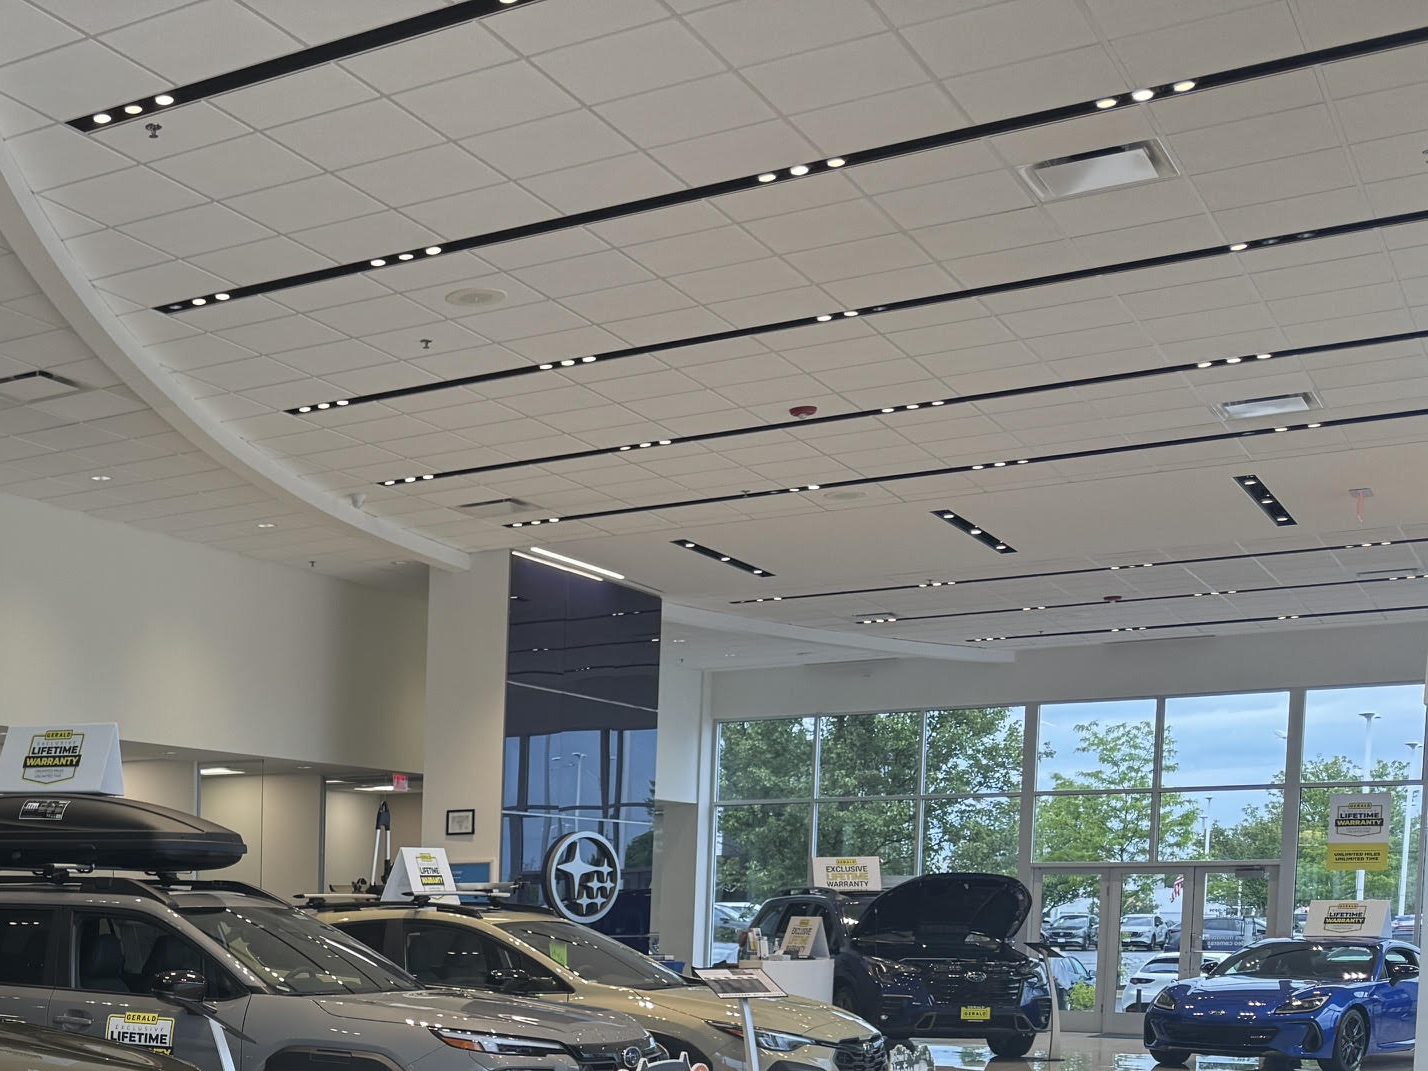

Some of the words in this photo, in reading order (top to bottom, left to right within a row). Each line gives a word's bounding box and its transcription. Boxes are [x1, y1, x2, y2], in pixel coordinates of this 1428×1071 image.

[31, 746, 79, 755] LIFETIME
[27, 757, 79, 766] WARRANTY
[825, 865, 868, 873] EXCLUSIVE
[126, 1014, 157, 1023] GERALD
[115, 1024, 165, 1032] EXCLUSIVE
[110, 1030, 168, 1045] LIFETIME
